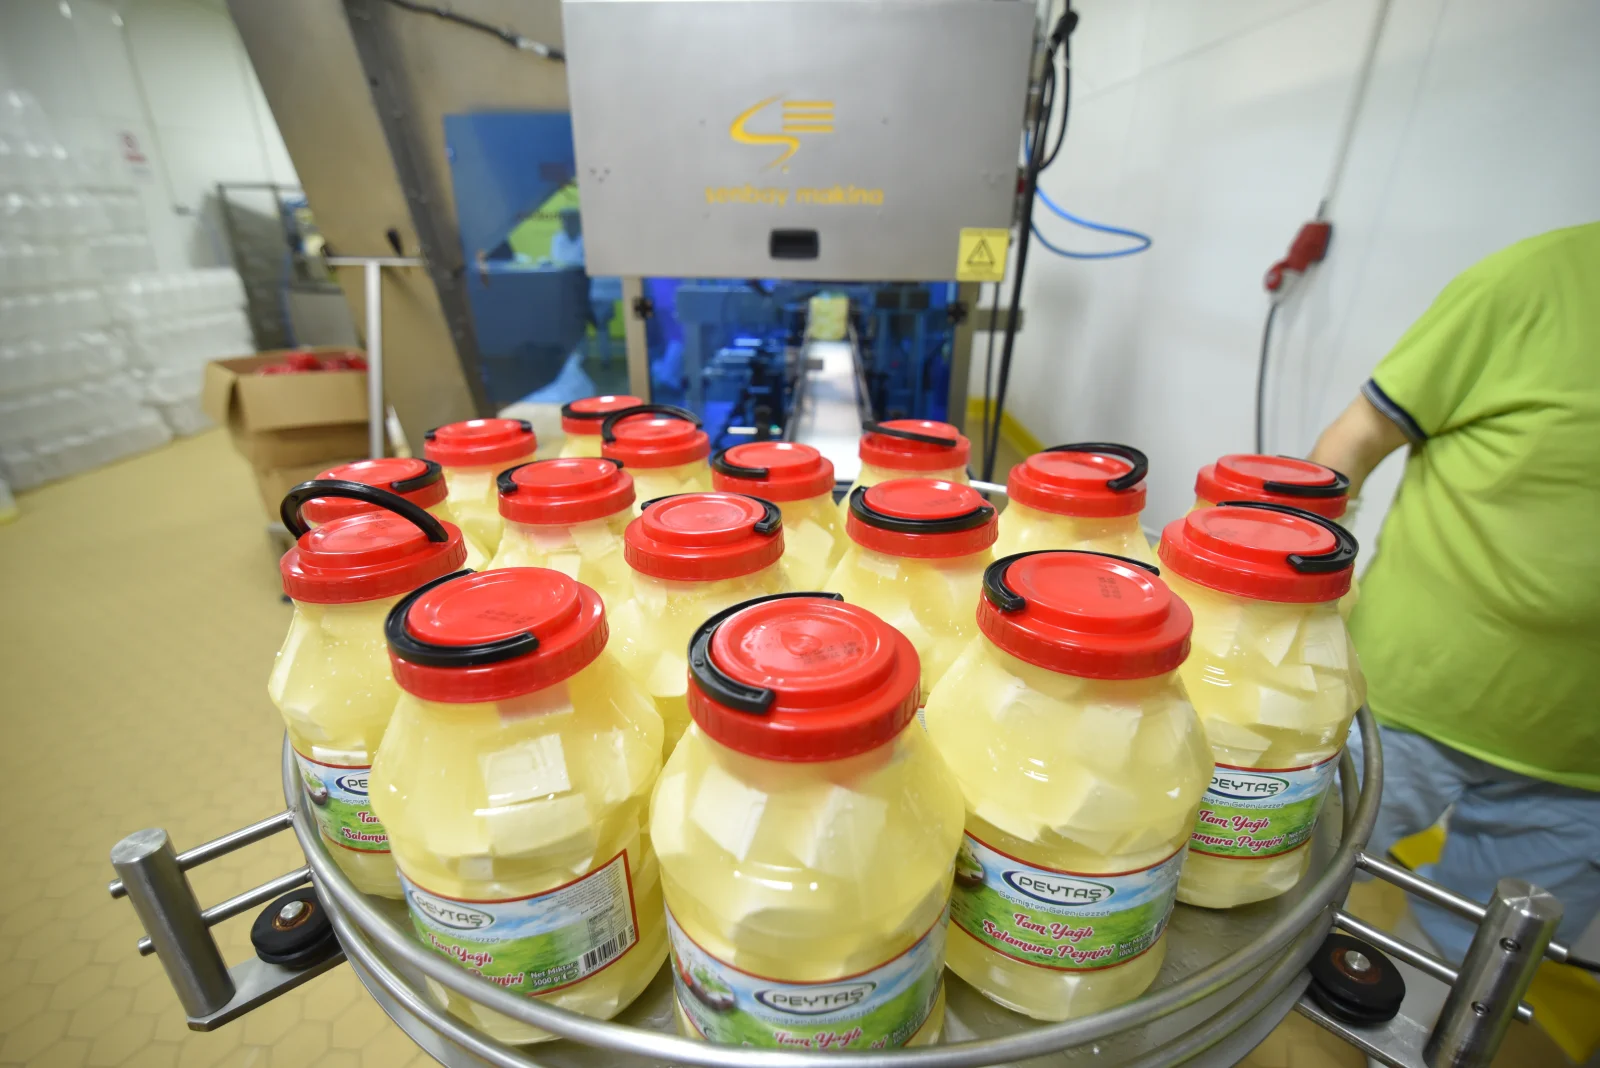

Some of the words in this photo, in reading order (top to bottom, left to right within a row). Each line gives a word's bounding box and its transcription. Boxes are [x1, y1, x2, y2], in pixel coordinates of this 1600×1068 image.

[795, 182, 884, 206] makina
[1199, 809, 1229, 828] Tam
[1231, 815, 1269, 834] Yağlı
[342, 827, 388, 843] Salamu
[1191, 832, 1234, 847] amura
[1237, 834, 1286, 852] Peyniri
[1018, 875, 1103, 902] PEYTAŞ
[415, 895, 484, 927] PEYTAŞ
[1013, 912, 1047, 936] Tam
[1049, 921, 1095, 943] Yağlı
[427, 931, 453, 956] Tam
[452, 942, 494, 968] Yağlı
[982, 918, 1054, 957] Salamura
[1057, 942, 1117, 965] Peyniri
[530, 971, 546, 980] Net
[772, 987, 865, 1007] PEYTAŞ
[774, 1031, 811, 1047] Tam
[814, 1026, 863, 1048] Yağlı
